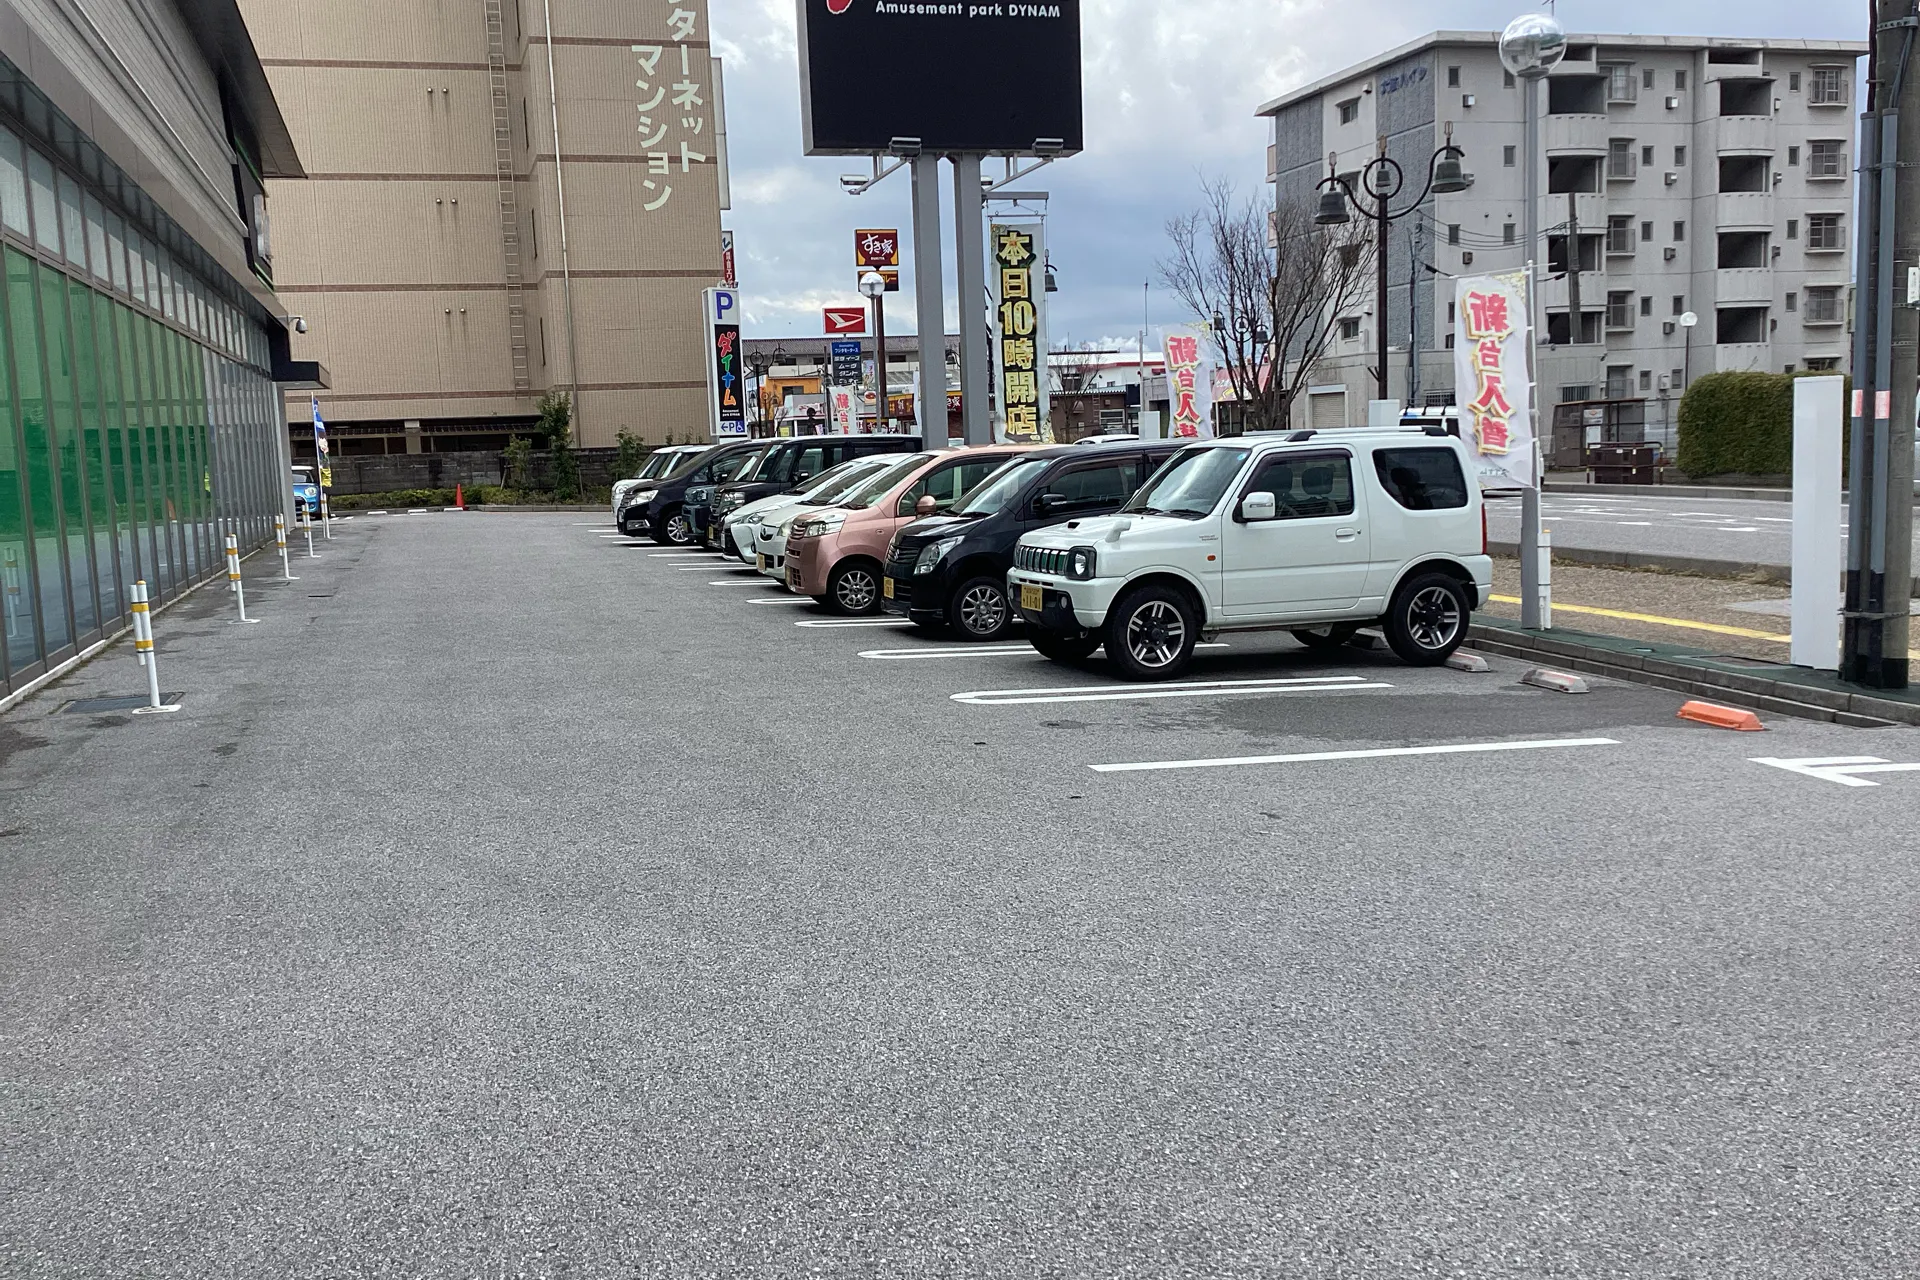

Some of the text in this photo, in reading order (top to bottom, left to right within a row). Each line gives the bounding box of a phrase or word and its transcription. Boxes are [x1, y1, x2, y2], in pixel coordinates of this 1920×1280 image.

[875, 1, 1061, 18] Amusement park DYNAM
[666, 0, 707, 173] ターネット
[631, 45, 672, 211] マンション
[861, 233, 894, 256] すき家
[715, 291, 733, 319] P
[999, 231, 1039, 436] 本日10時開店
[718, 331, 737, 406] ダイナム
[729, 422, 735, 432] P
